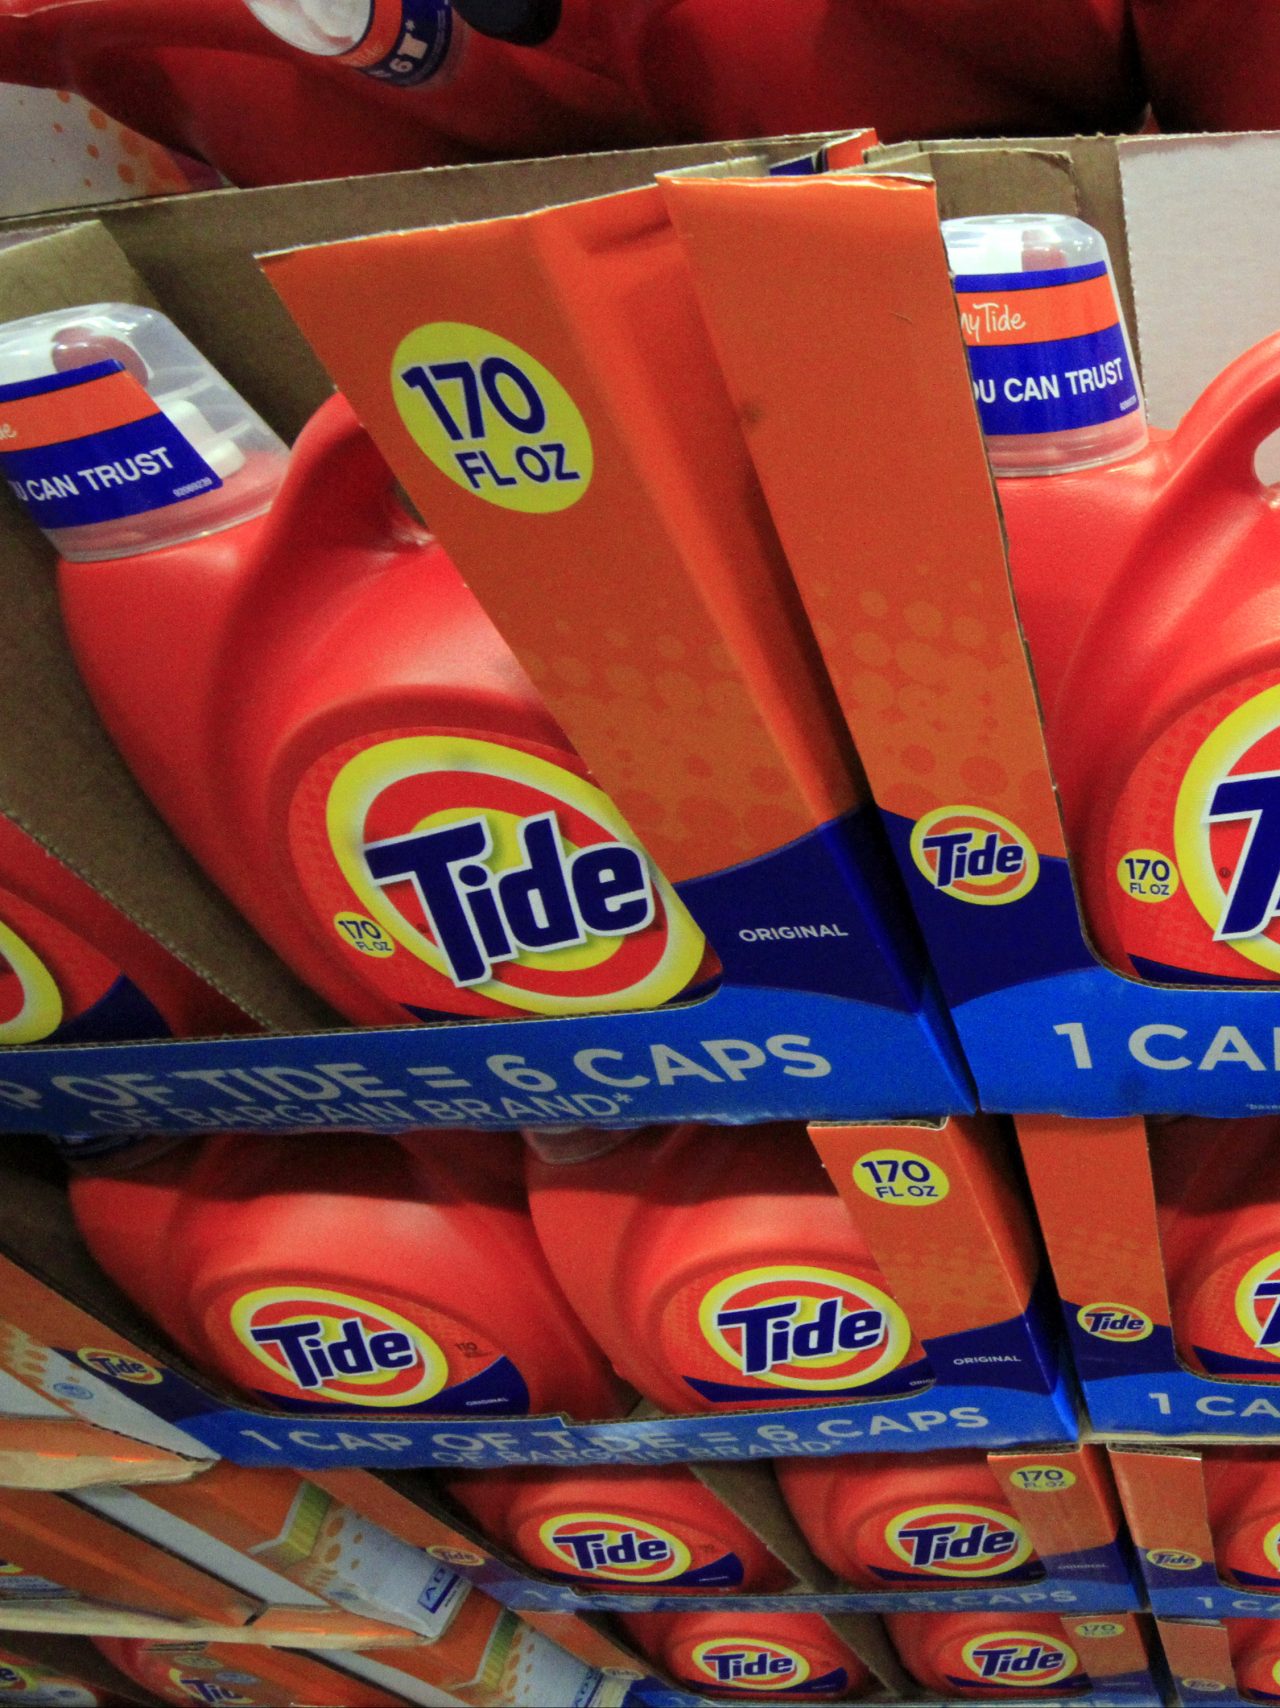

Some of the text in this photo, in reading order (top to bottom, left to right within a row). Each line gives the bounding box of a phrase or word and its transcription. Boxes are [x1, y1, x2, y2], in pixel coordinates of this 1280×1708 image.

[973, 302, 1027, 334] Tide
[1003, 357, 1124, 404] CAN TRUST
[401, 356, 546, 441] 170
[26, 475, 80, 501] CAN
[78, 446, 174, 491] TRUST
[455, 443, 581, 490] FL OZ
[922, 831, 1024, 889] Tide
[1125, 858, 1170, 882] 170
[364, 810, 656, 988] Tide
[1130, 882, 1170, 896] FL OZ
[337, 920, 382, 940] 170
[738, 923, 849, 942] ORIGINAL
[1053, 1022, 1094, 1070] 1
[50, 1033, 832, 1107] OF TIDE = 6 CAPS
[90, 1108, 162, 1127] OF
[165, 1098, 405, 1128] BARGAIN
[861, 1160, 931, 1184] 170
[875, 1185, 939, 1198] FL OZ
[717, 1296, 888, 1377] Tide
[1084, 1311, 1146, 1334] Tide
[88, 1357, 148, 1378] Tide
[250, 1317, 419, 1391] Tide
[953, 1355, 1022, 1366] ORIGINAL
[1148, 1392, 1172, 1415] 1
[240, 1406, 990, 1453] 1 CAP OF TDE = 6 CAPS
[1017, 1469, 1064, 1482] 170
[553, 1532, 671, 1570] Tide
[898, 1522, 1017, 1567] Tide
[1153, 1552, 1196, 1566] Tide
[952, 1590, 1078, 1606] CAPS
[1197, 1596, 1214, 1610] 1
[702, 1651, 795, 1682] Tide
[973, 1647, 1065, 1678] Tide
